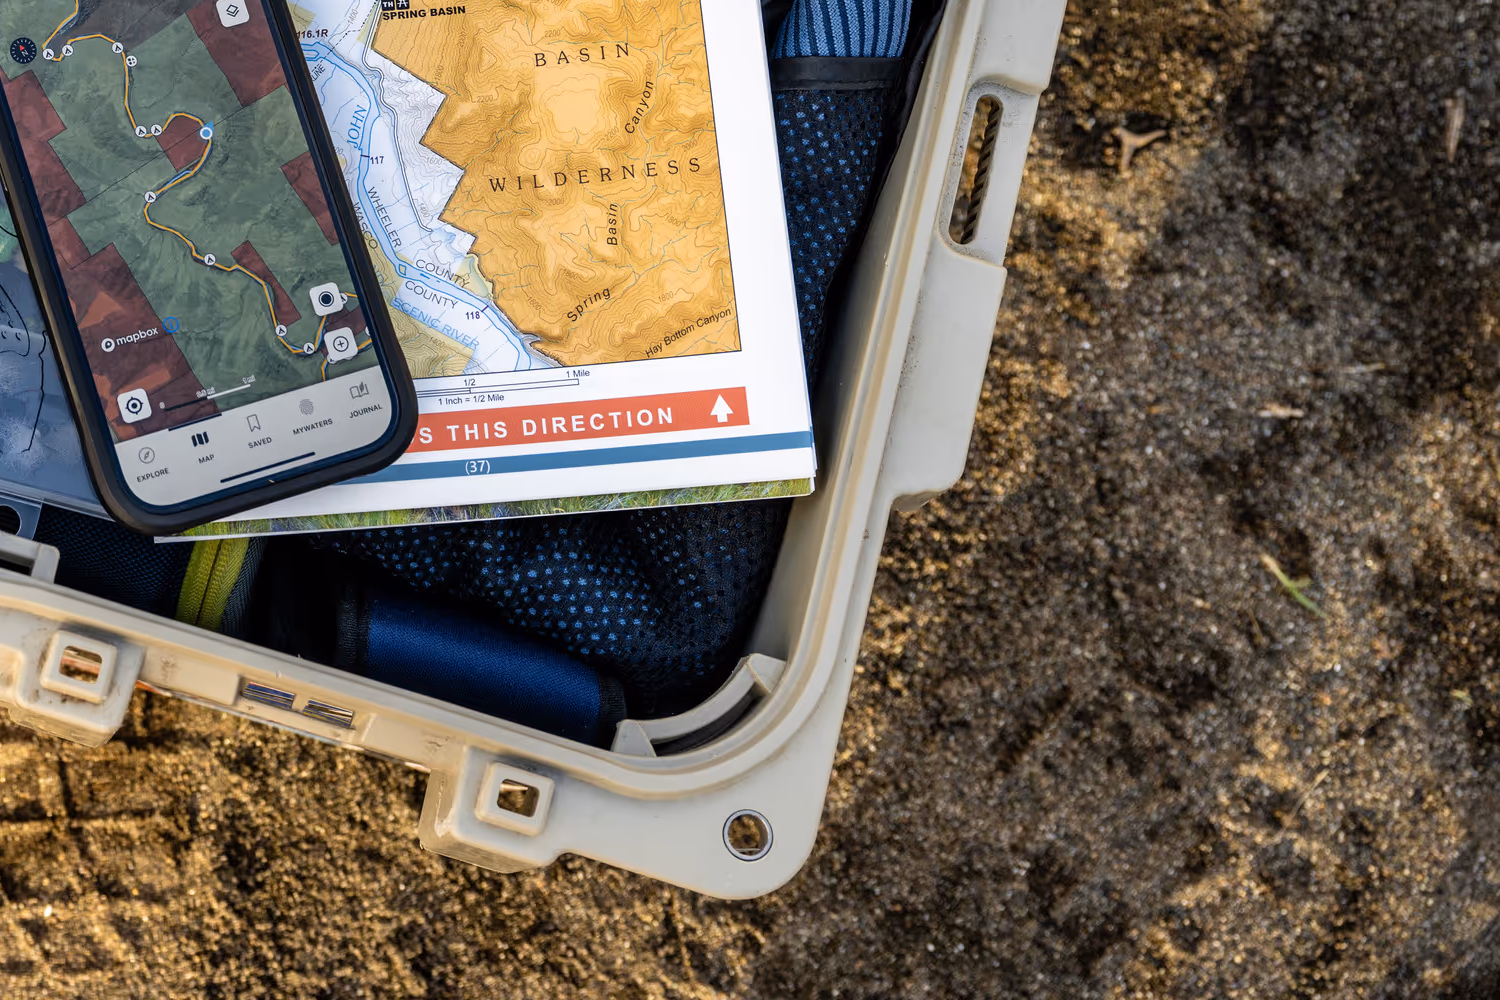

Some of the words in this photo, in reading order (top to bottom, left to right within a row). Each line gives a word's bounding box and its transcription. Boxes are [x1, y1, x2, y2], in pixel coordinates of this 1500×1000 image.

[382, 9, 427, 20] SPRING
[430, 5, 466, 17] BASIN
[534, 43, 630, 67] BASIN
[624, 80, 654, 134] Canyon
[346, 104, 367, 149] JOHN
[369, 156, 384, 164] 117
[489, 156, 701, 193] WILDERNESS
[352, 201, 379, 250] WASCO
[368, 186, 402, 248] WHEELER
[606, 202, 618, 246] Basin
[415, 258, 470, 287] COUNTY
[404, 280, 459, 309] COUNTY
[566, 287, 612, 323] Spring
[393, 296, 440, 329] SCENIC
[442, 324, 481, 350] RIVER
[465, 311, 481, 320] 118
[116, 327, 159, 347] mapbox
[645, 343, 663, 358] Hay
[664, 324, 695, 345] Bottom
[696, 308, 732, 328] Canyon
[463, 378, 476, 387] 1/2
[572, 369, 591, 378] Mile
[444, 397, 463, 405] Inch
[473, 395, 485, 404] 1/2
[487, 393, 505, 402] Mile
[349, 403, 384, 419] JOURNAL
[292, 418, 334, 436] MYWATERS
[446, 421, 509, 442] THIS
[522, 407, 673, 437] DIRECTION
[247, 436, 273, 449] SAVED
[197, 454, 215, 465] MAP
[465, 459, 491, 475] (37)
[136, 467, 170, 483] EXPLORE
